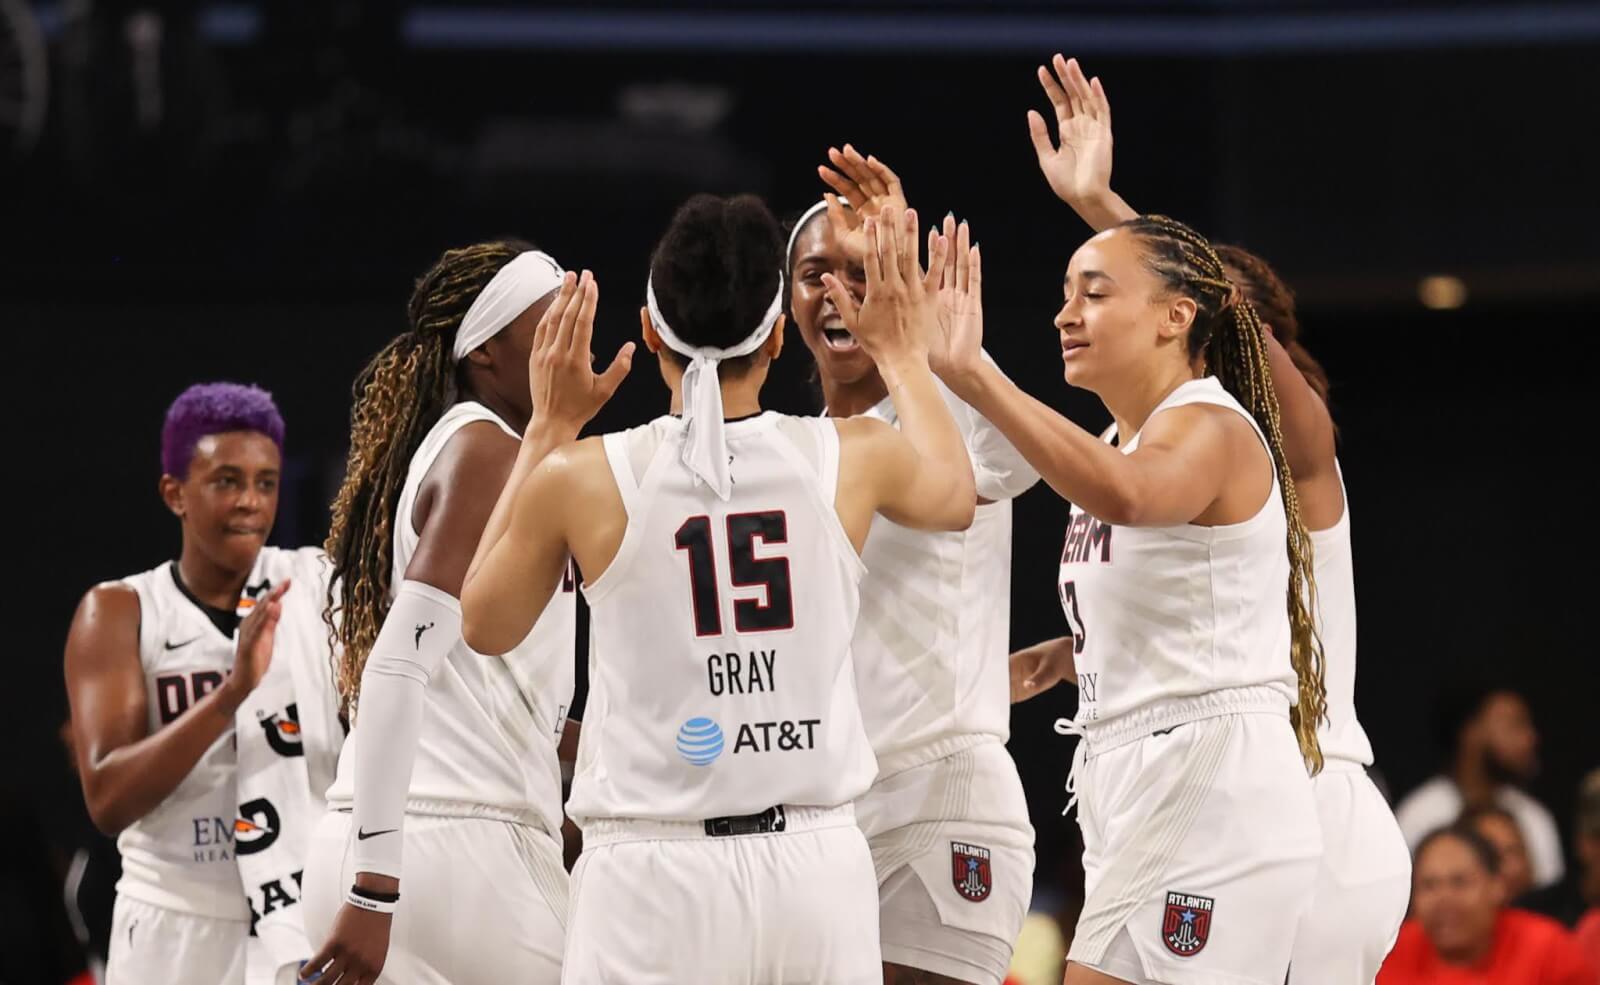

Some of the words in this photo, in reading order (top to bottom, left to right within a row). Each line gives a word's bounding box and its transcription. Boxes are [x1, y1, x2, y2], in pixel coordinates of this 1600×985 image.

[674, 509, 794, 637] 15
[708, 650, 776, 696] GRAY
[733, 720, 821, 754] AT&T
[953, 843, 989, 860] ATLANTA
[1168, 893, 1212, 911] ATLANTA
